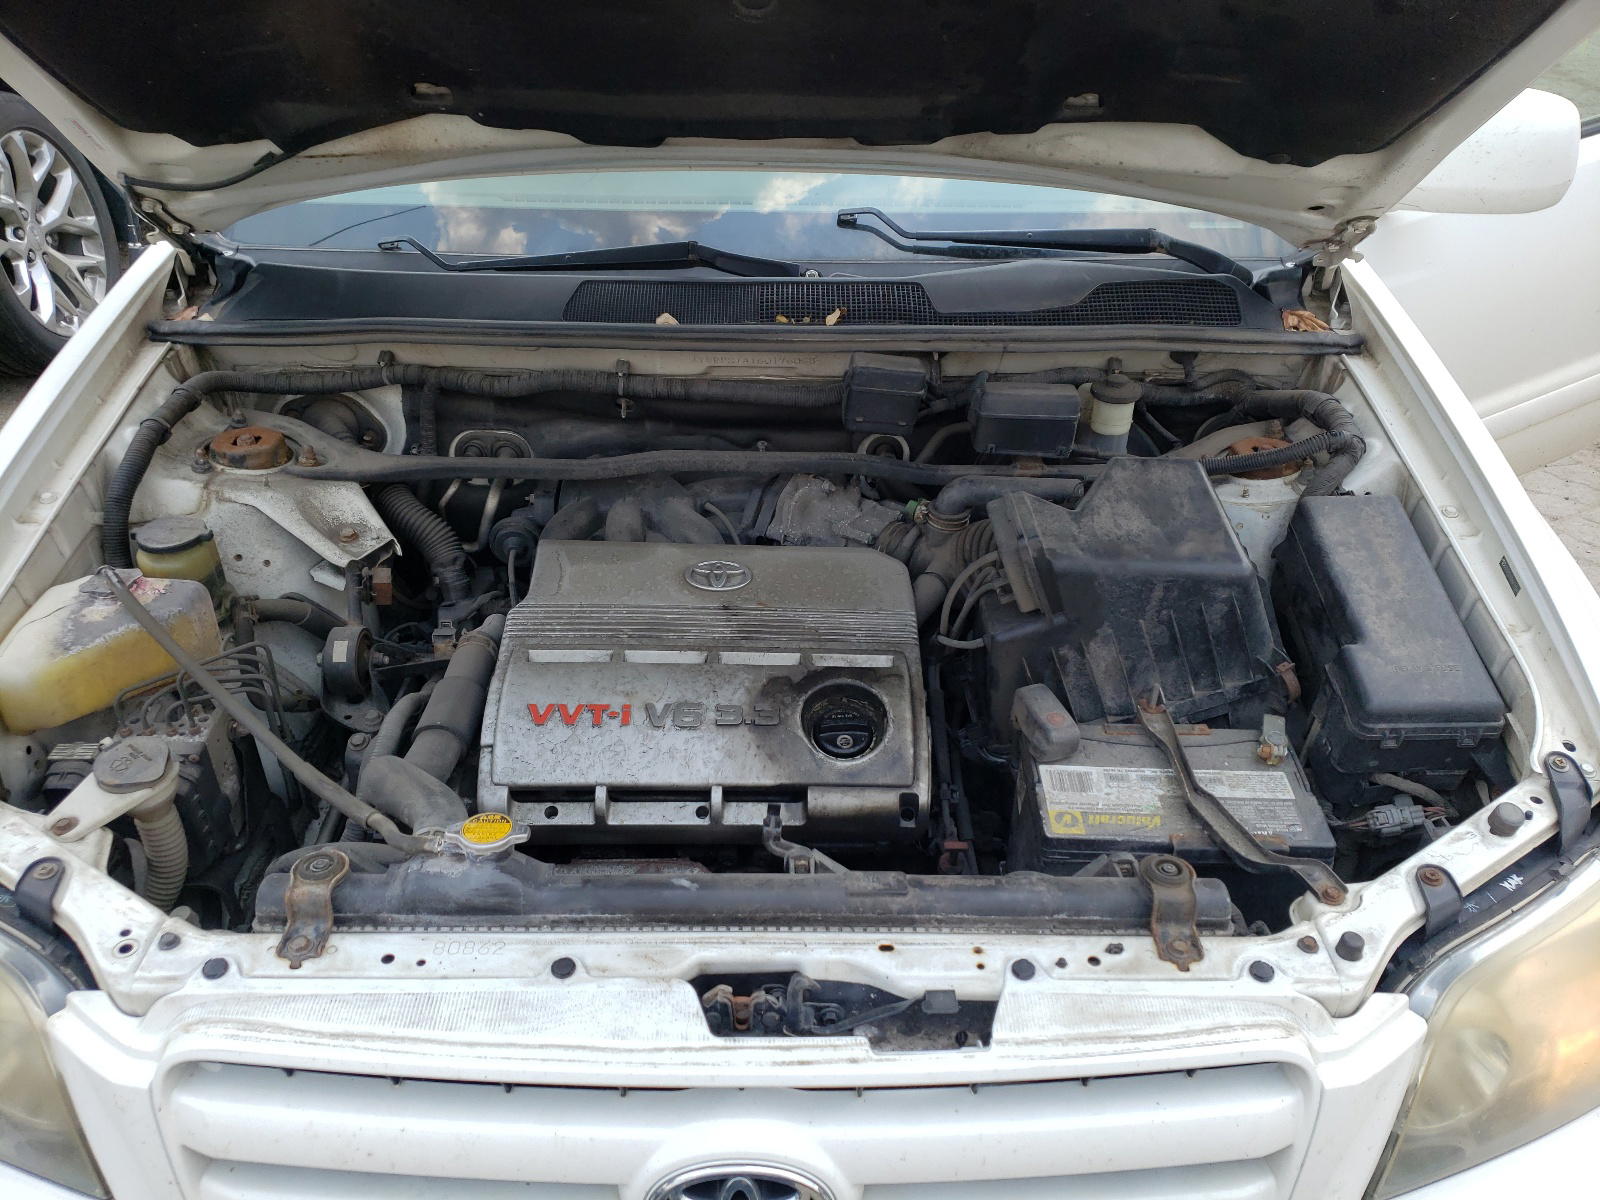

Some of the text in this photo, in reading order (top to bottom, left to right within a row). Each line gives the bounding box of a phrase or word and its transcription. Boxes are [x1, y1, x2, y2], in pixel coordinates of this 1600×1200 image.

[527, 702, 782, 728] VVT-i V6 3.3
[432, 940, 507, 956] 80862
